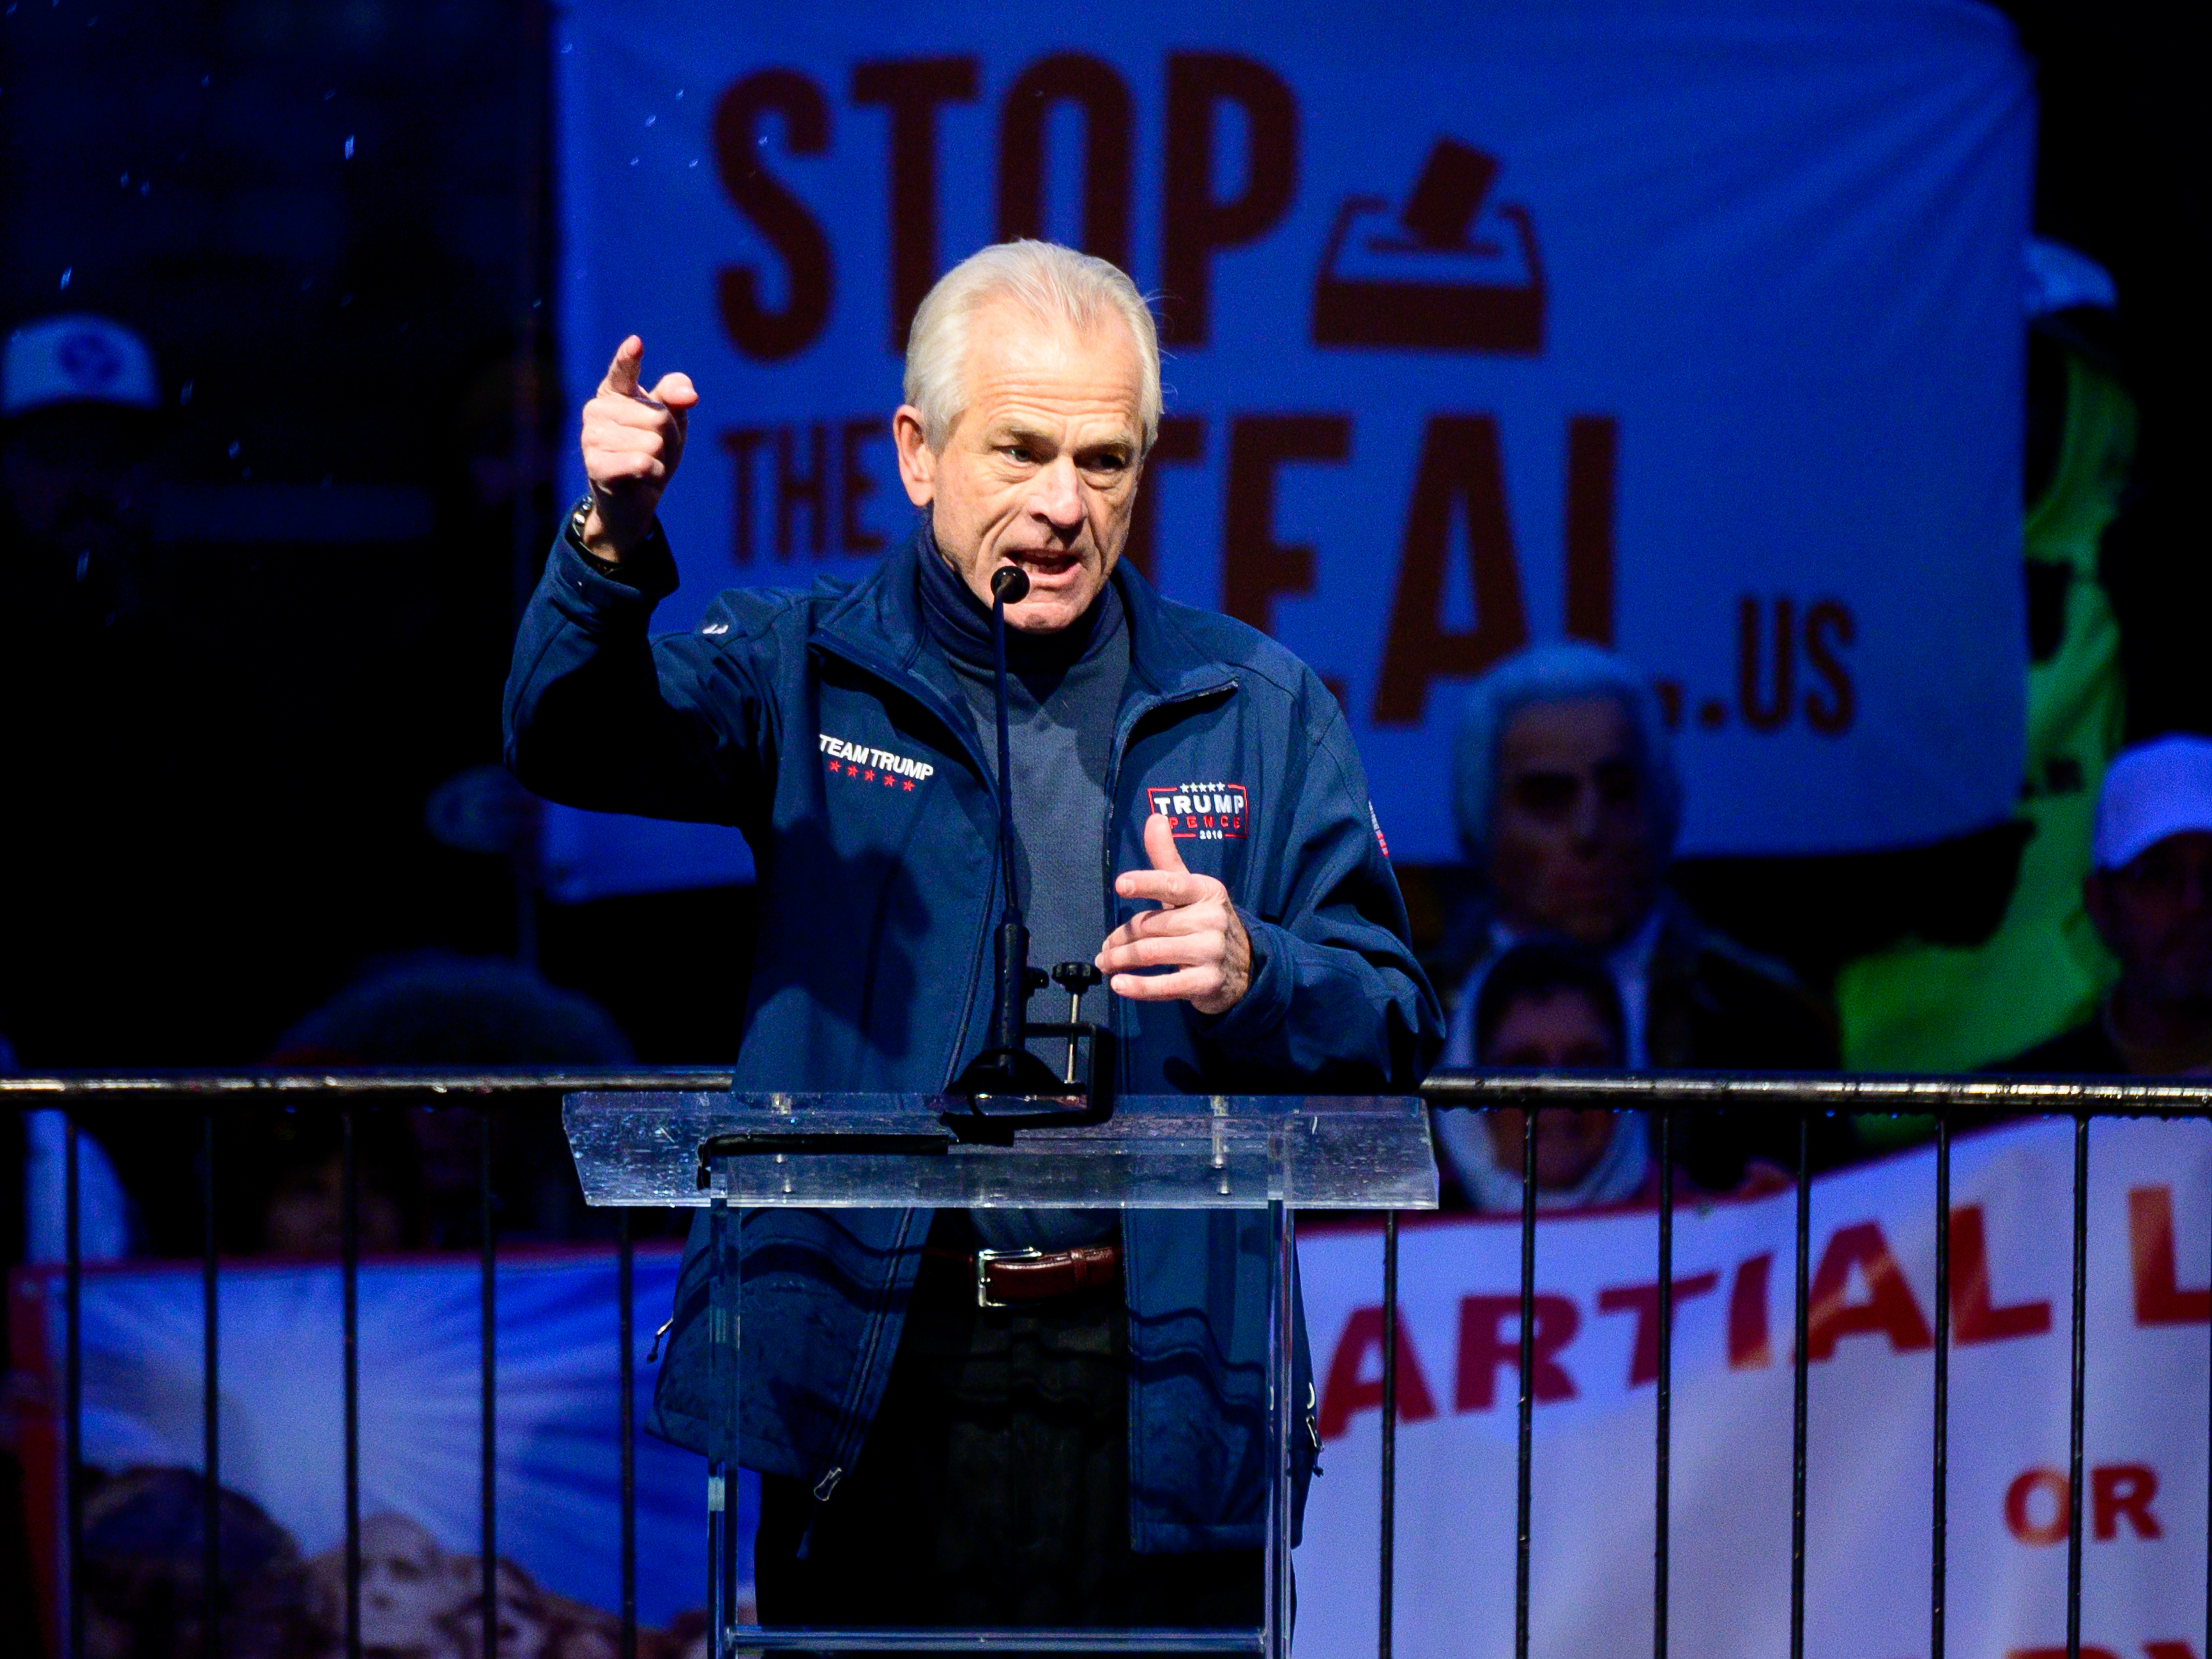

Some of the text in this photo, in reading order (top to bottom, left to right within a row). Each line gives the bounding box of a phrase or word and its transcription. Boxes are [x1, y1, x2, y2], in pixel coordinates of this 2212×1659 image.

[712, 51, 1301, 363] STOP
[721, 418, 889, 567] THE
[819, 733, 934, 781] TEAM TRUMP
[1154, 794, 1244, 815] TRUMP
[1169, 815, 1240, 829] PENCE
[1316, 1205, 2050, 1439] ARTIAL
[2004, 1465, 2162, 1546] OR
